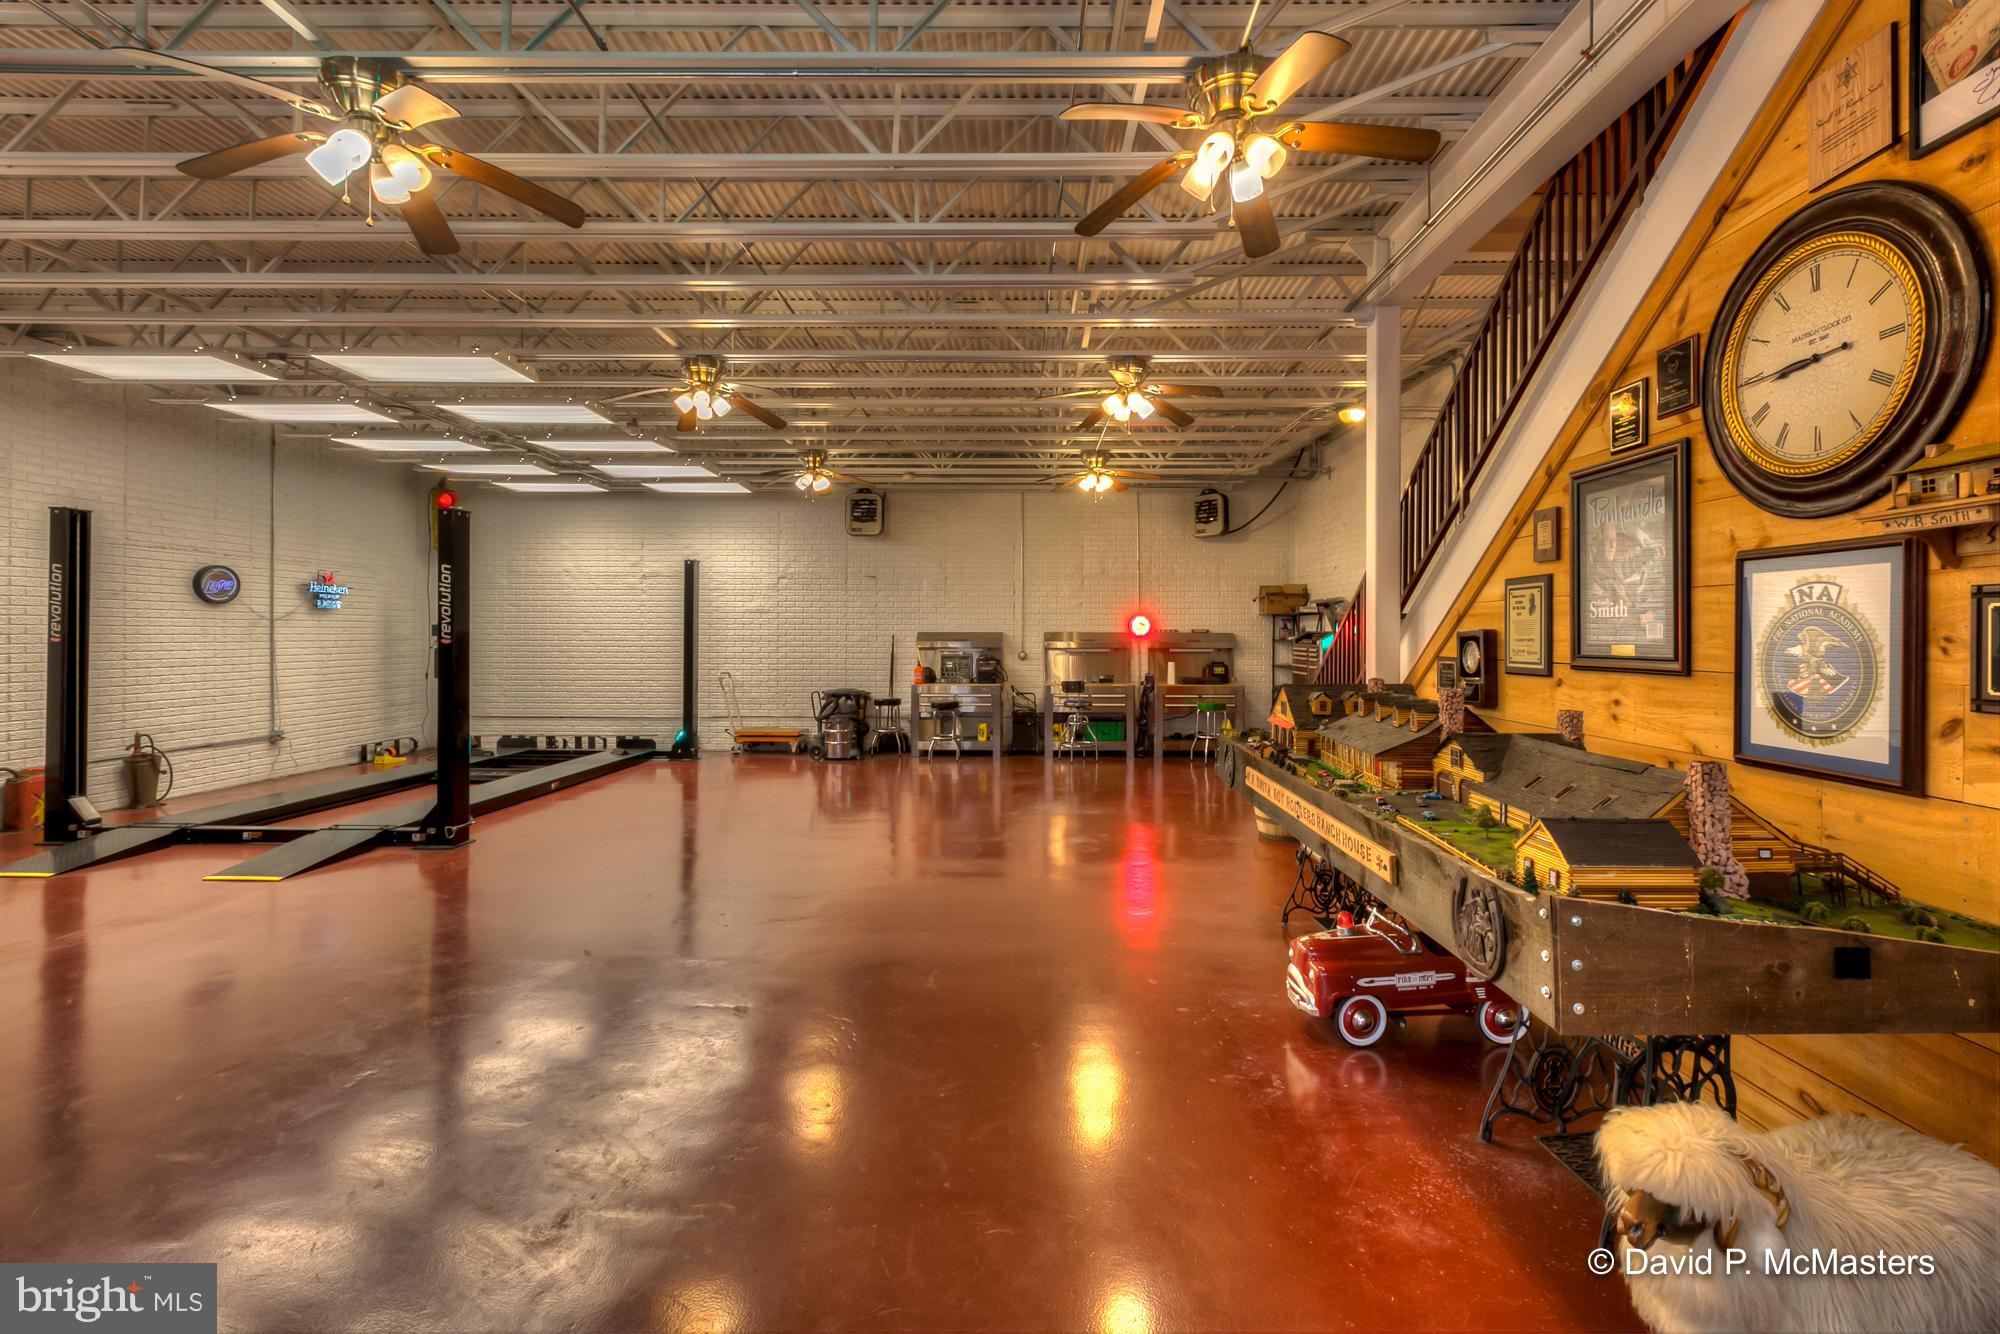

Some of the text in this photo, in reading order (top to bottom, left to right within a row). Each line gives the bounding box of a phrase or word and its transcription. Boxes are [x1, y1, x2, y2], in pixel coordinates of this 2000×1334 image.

[49, 563, 63, 637] revolution
[309, 581, 349, 595] Heineken
[439, 563, 452, 639] revolution
[1796, 585, 1834, 602] NA
[1589, 599, 1628, 619] Smith
[1784, 608, 1825, 626] NATIONAL
[1829, 610, 1865, 643] ACADEMY
[1316, 813, 1341, 845] RANCH
[1342, 831, 1372, 863] HOUSE
